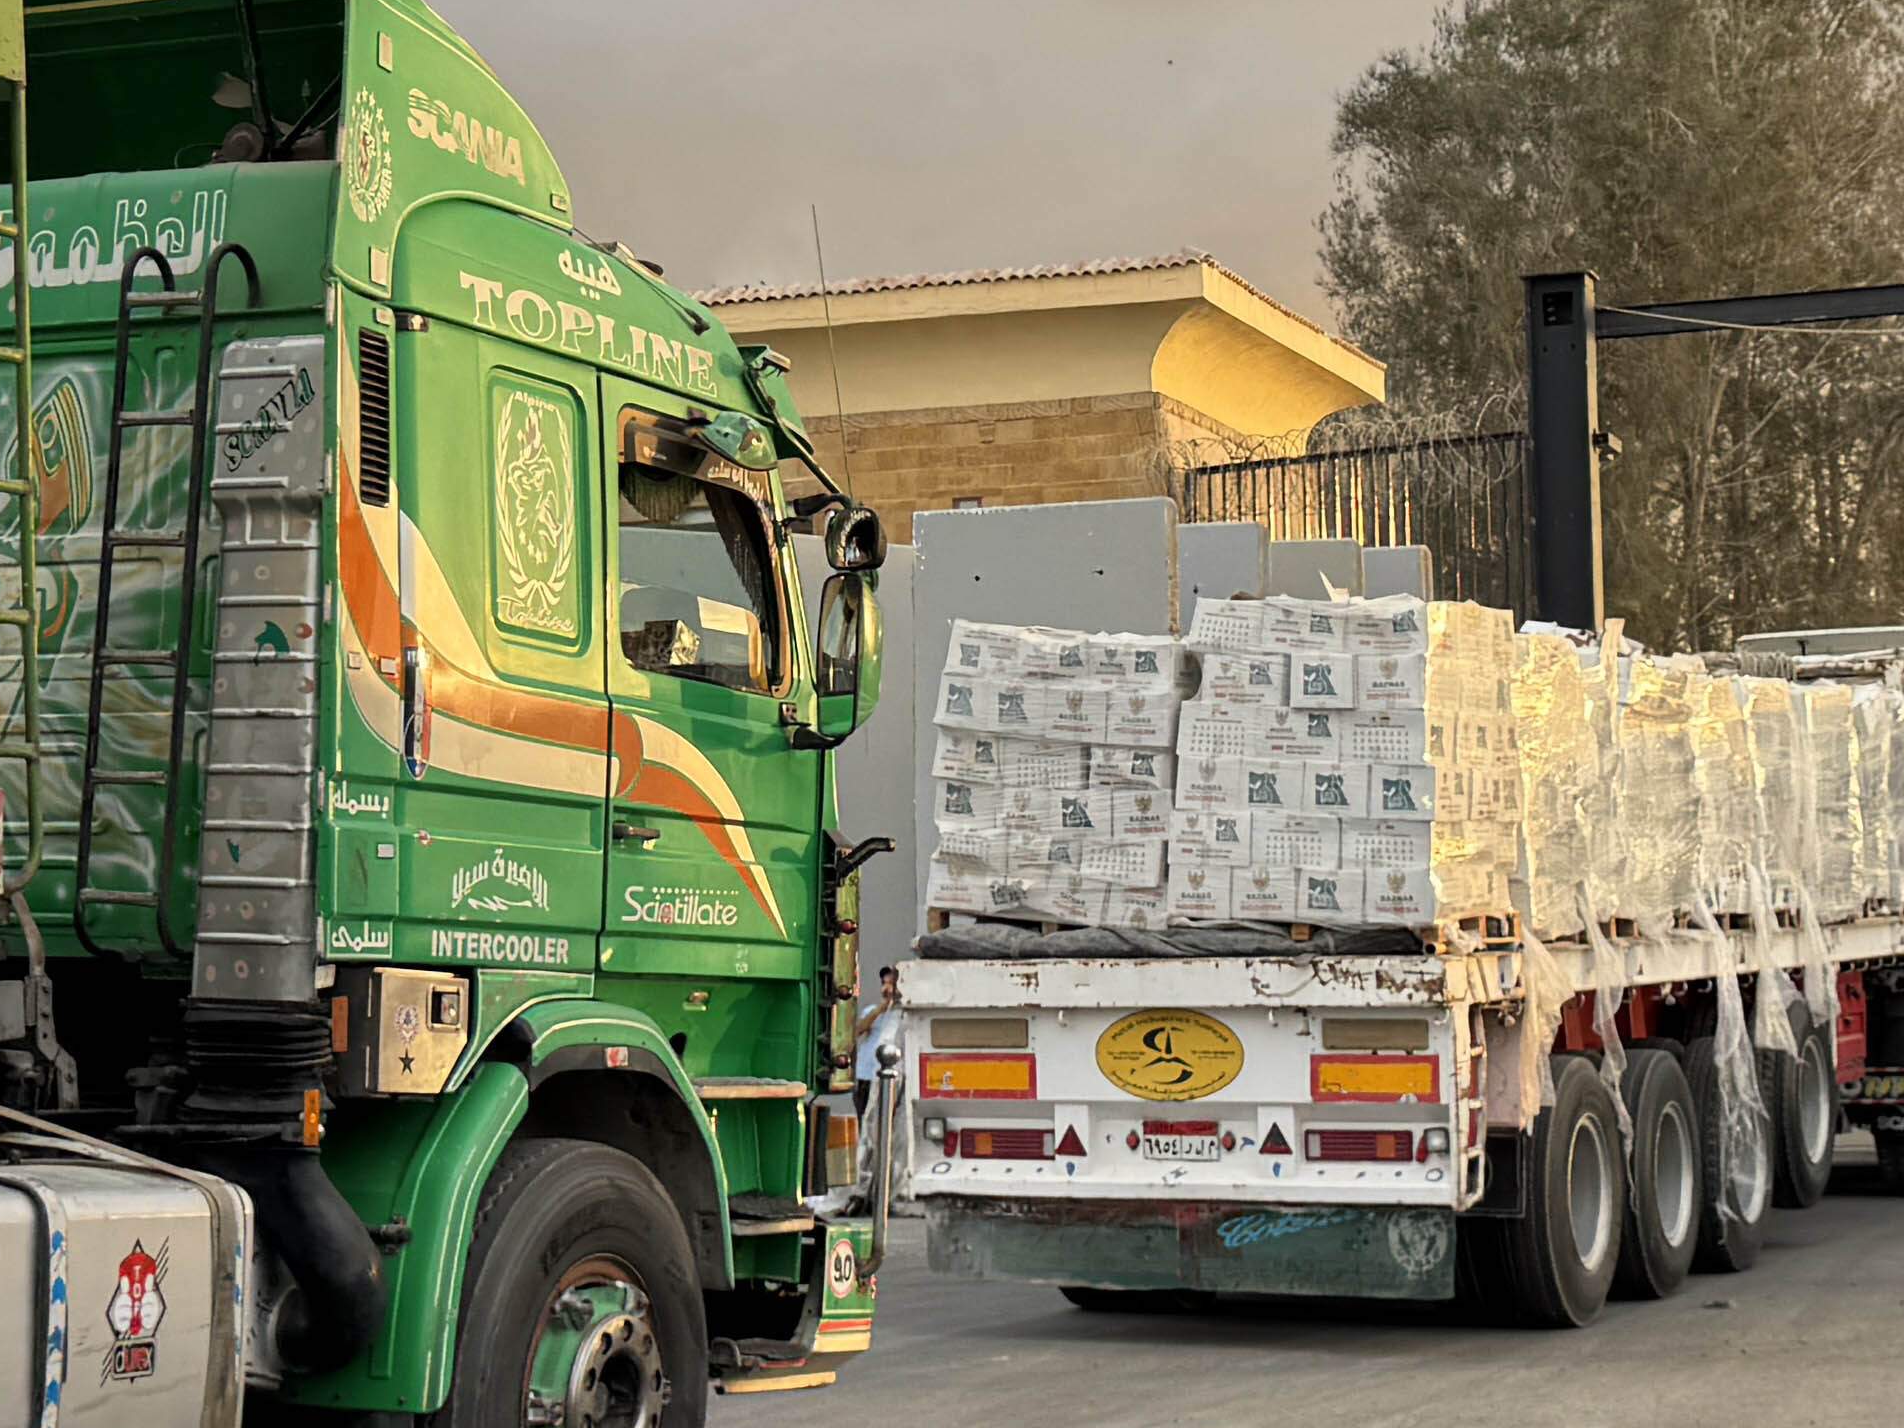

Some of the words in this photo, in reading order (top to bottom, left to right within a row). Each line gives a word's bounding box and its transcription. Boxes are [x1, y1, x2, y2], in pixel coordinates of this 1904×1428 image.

[408, 88, 527, 188] SCANIA
[459, 270, 718, 399] TOPLINE
[621, 885, 738, 925] Scintillate
[431, 929, 569, 965] INTERCOOLER
